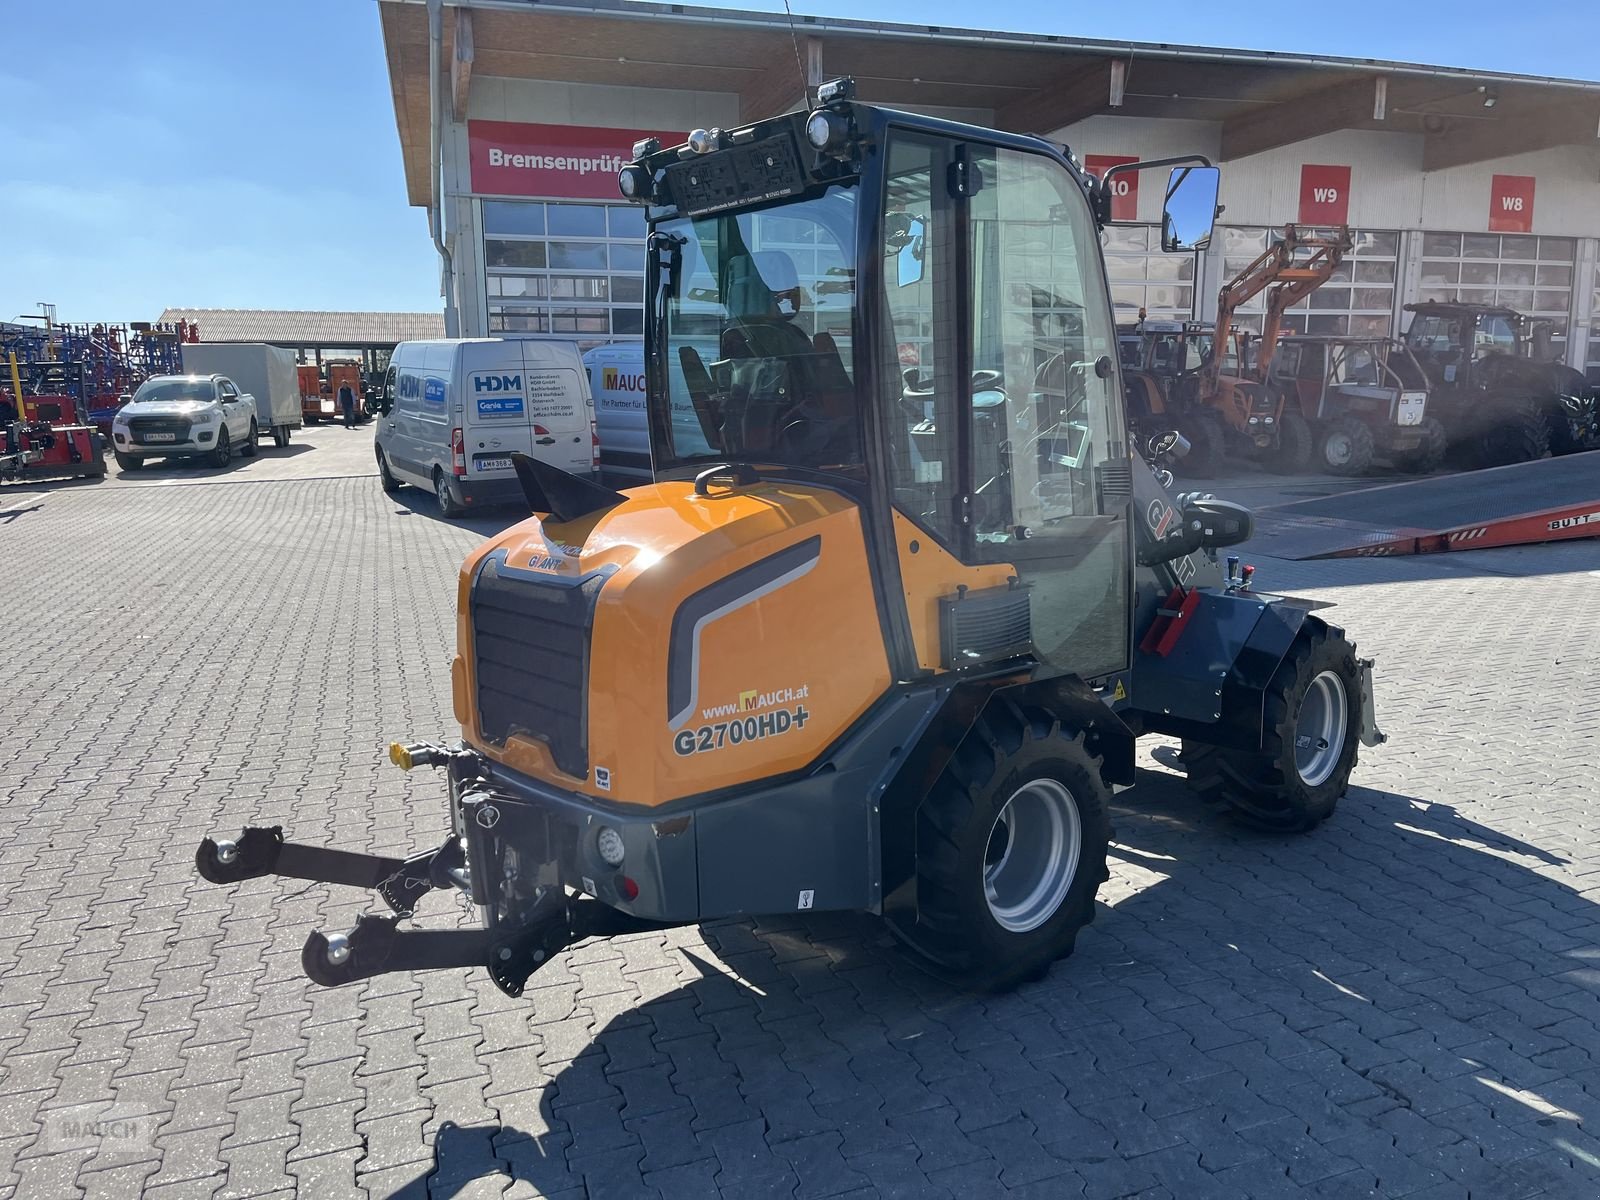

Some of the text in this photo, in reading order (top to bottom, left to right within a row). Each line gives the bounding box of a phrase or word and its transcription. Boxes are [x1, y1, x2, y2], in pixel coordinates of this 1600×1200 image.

[1110, 180, 1129, 197] 10
[1313, 188, 1338, 203] W9
[1502, 196, 1523, 212] W8
[474, 375, 522, 392] HDM
[606, 374, 647, 392] MAUC
[480, 401, 502, 410] Genie
[611, 400, 632, 408] Partner
[1551, 514, 1590, 530] BUTT
[528, 554, 562, 572] GIANT
[702, 684, 809, 719] www.MAUCH.at
[673, 704, 809, 757] G2700HD+
